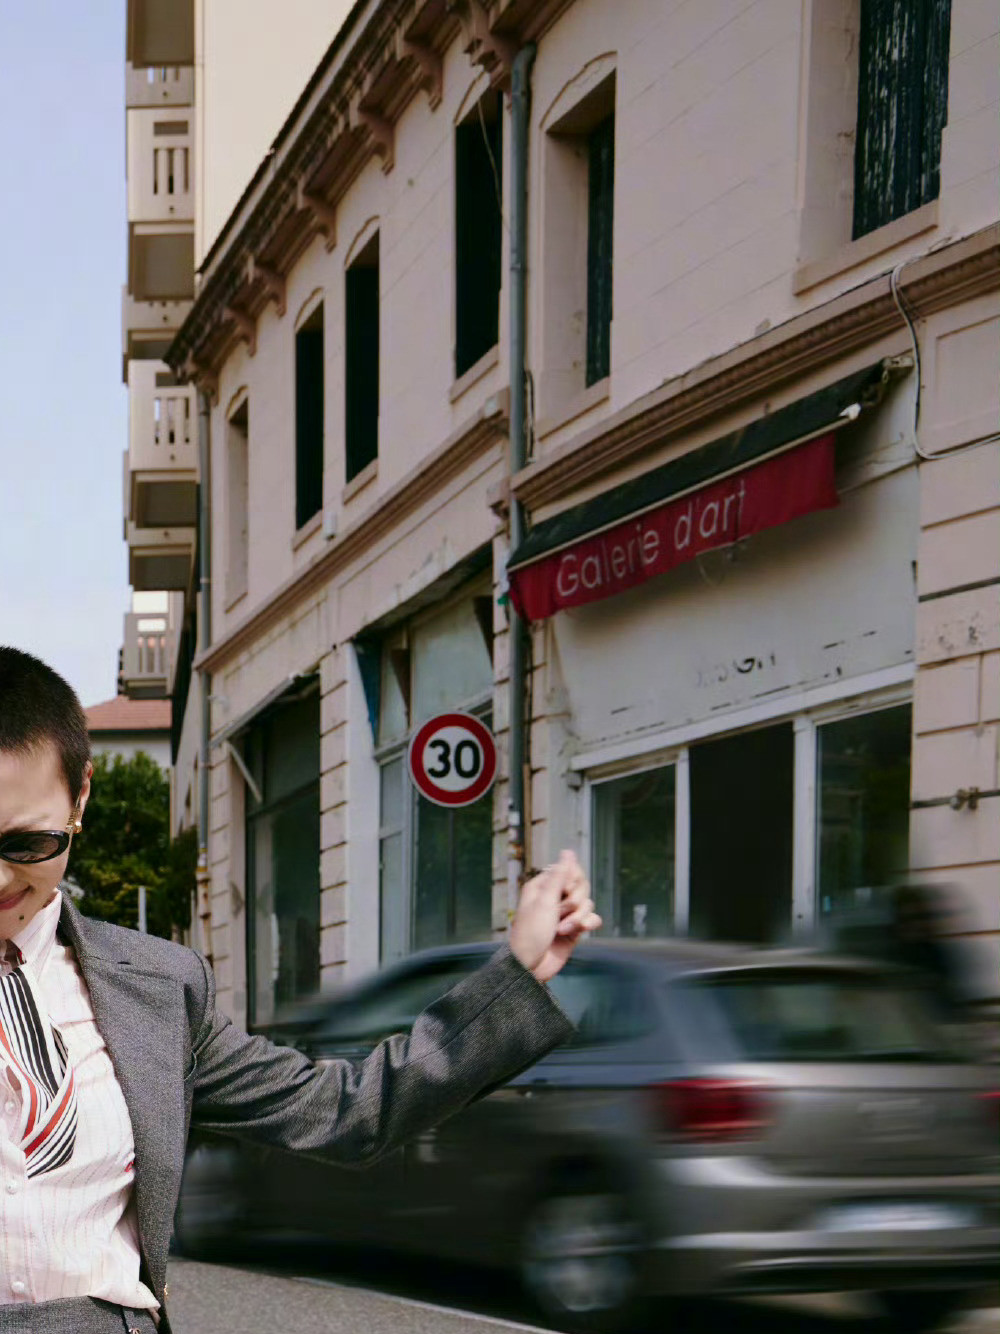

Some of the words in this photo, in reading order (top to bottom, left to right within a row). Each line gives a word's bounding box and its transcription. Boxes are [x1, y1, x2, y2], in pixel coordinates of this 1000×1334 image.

[556, 522, 660, 597] Galerie
[673, 478, 747, 550] d'art
[427, 738, 481, 779] 30
